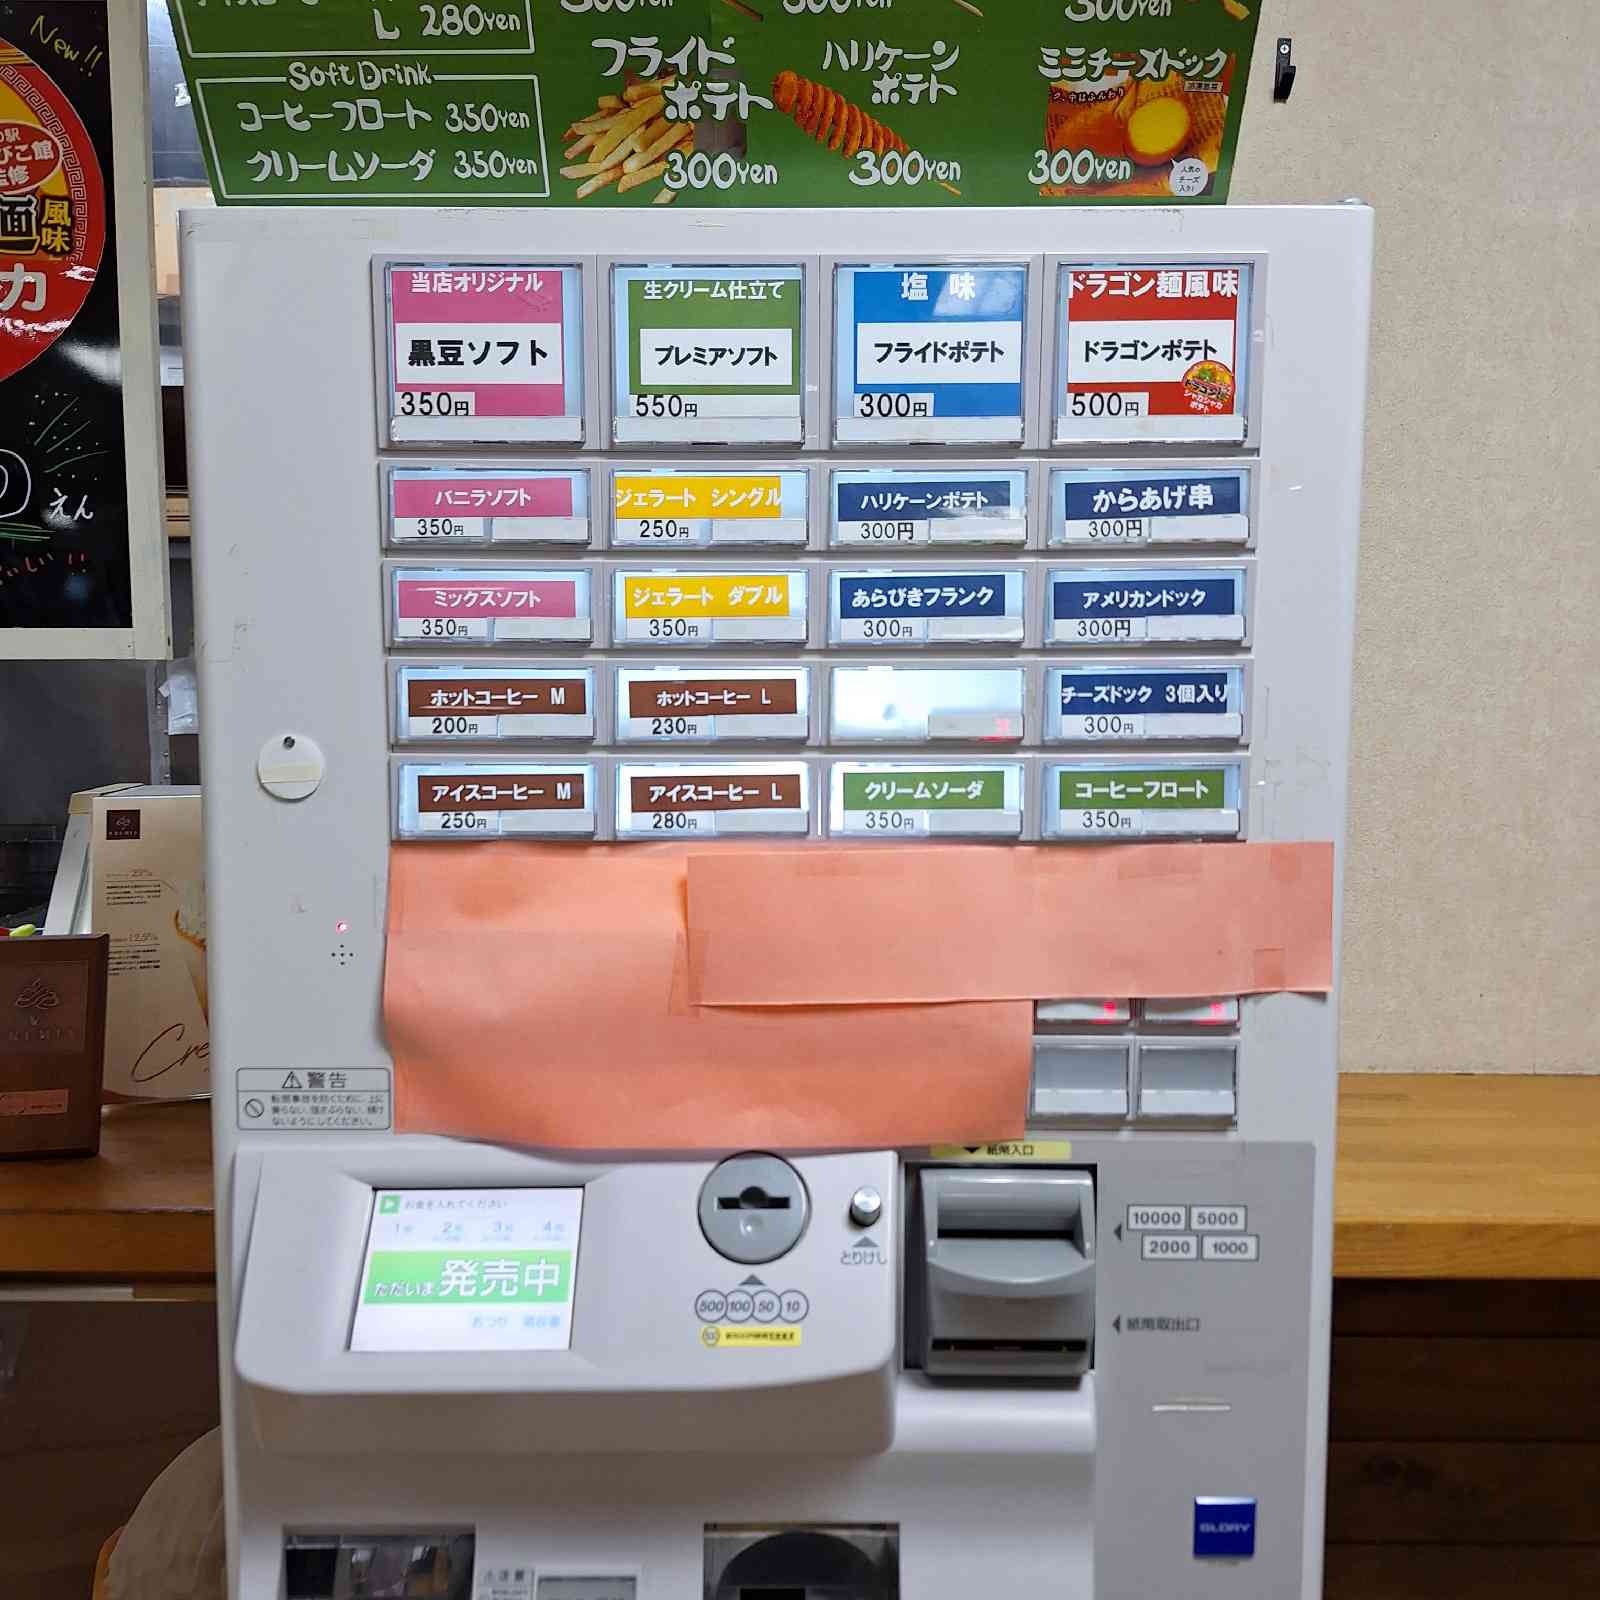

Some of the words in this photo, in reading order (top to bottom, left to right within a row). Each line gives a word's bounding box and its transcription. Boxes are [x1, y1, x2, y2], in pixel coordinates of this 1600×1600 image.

[373, 8, 400, 40] L
[30, 15, 103, 77] New!!
[822, 39, 960, 72] ハリケーン
[591, 35, 736, 78] フライド
[1038, 47, 1229, 80] ミニチーズドック
[287, 61, 356, 92] Soft
[358, 60, 432, 91] Drink
[870, 73, 959, 105] ポテト
[663, 79, 775, 122] ポテト
[236, 98, 432, 133] コーヒーフロート
[246, 148, 437, 183] クリームソーダ
[42, 199, 72, 253] 風味
[411, 272, 543, 294] 当店オリジナル
[643, 281, 785, 300] 生クリーム仕立て
[1068, 271, 1239, 299] ドラゴン麺風味
[408, 339, 548, 367] 黒豆ソフト
[654, 345, 778, 369] プレミアソフト
[874, 340, 1005, 365] フライドポテト
[1084, 339, 1218, 363] ドラゴンポテト
[400, 391, 470, 416] 350円
[635, 394, 698, 417] 550円
[860, 392, 928, 418] 300円
[1071, 392, 1139, 417] 500円
[50, 487, 94, 520] えん
[434, 488, 531, 508] バニラソフト
[616, 489, 697, 508] ジェラート
[711, 489, 781, 508] シングル
[860, 491, 989, 511] ハリケーンポテト
[1093, 484, 1215, 513] からあげ串
[417, 518, 464, 536] 350円
[639, 520, 689, 539] 250円
[860, 522, 914, 540] 300円
[1088, 518, 1143, 538] 300円
[434, 589, 541, 608] ミックスソフト
[633, 588, 714, 606] ジェラート
[728, 586, 783, 605] ダブル
[851, 586, 995, 607] あらびきフランク
[1082, 589, 1207, 610] アメリカンドック
[422, 618, 468, 637] 350円
[649, 618, 699, 637] 350円
[862, 618, 913, 638] 300円
[1076, 618, 1131, 638] 300円
[430, 689, 538, 707] ホットコーヒー
[550, 687, 565, 705] M
[656, 690, 751, 708] ホットコーヒー
[760, 687, 771, 704] L
[1061, 684, 1152, 704] チーズドック
[1164, 684, 1227, 704] 3個入り
[432, 717, 478, 736] 200円
[652, 717, 698, 736] 230円
[1084, 716, 1134, 735] 300円
[432, 784, 543, 802] アイスコーヒー
[557, 783, 571, 801] M
[649, 784, 760, 802] アイスコーヒー
[772, 783, 782, 801] L
[864, 780, 985, 800] クリームソーダ
[1074, 780, 1210, 801] コーヒーフロート
[440, 813, 488, 830] 250円
[652, 813, 698, 830] 280円
[865, 811, 914, 830] 350円
[1082, 811, 1132, 830] 350円
[308, 1072, 348, 1089] 警告
[1133, 1212, 1182, 1225] 10000
[1196, 1212, 1239, 1226] 5000
[840, 1250, 888, 1265] とりけし
[1149, 1241, 1191, 1254] 2000
[1212, 1241, 1248, 1255] 1000
[439, 1256, 561, 1298] 発売中
[699, 1301, 724, 1312] 500
[728, 1301, 750, 1312] 100
[758, 1301, 774, 1312] 50
[786, 1301, 800, 1312] 10
